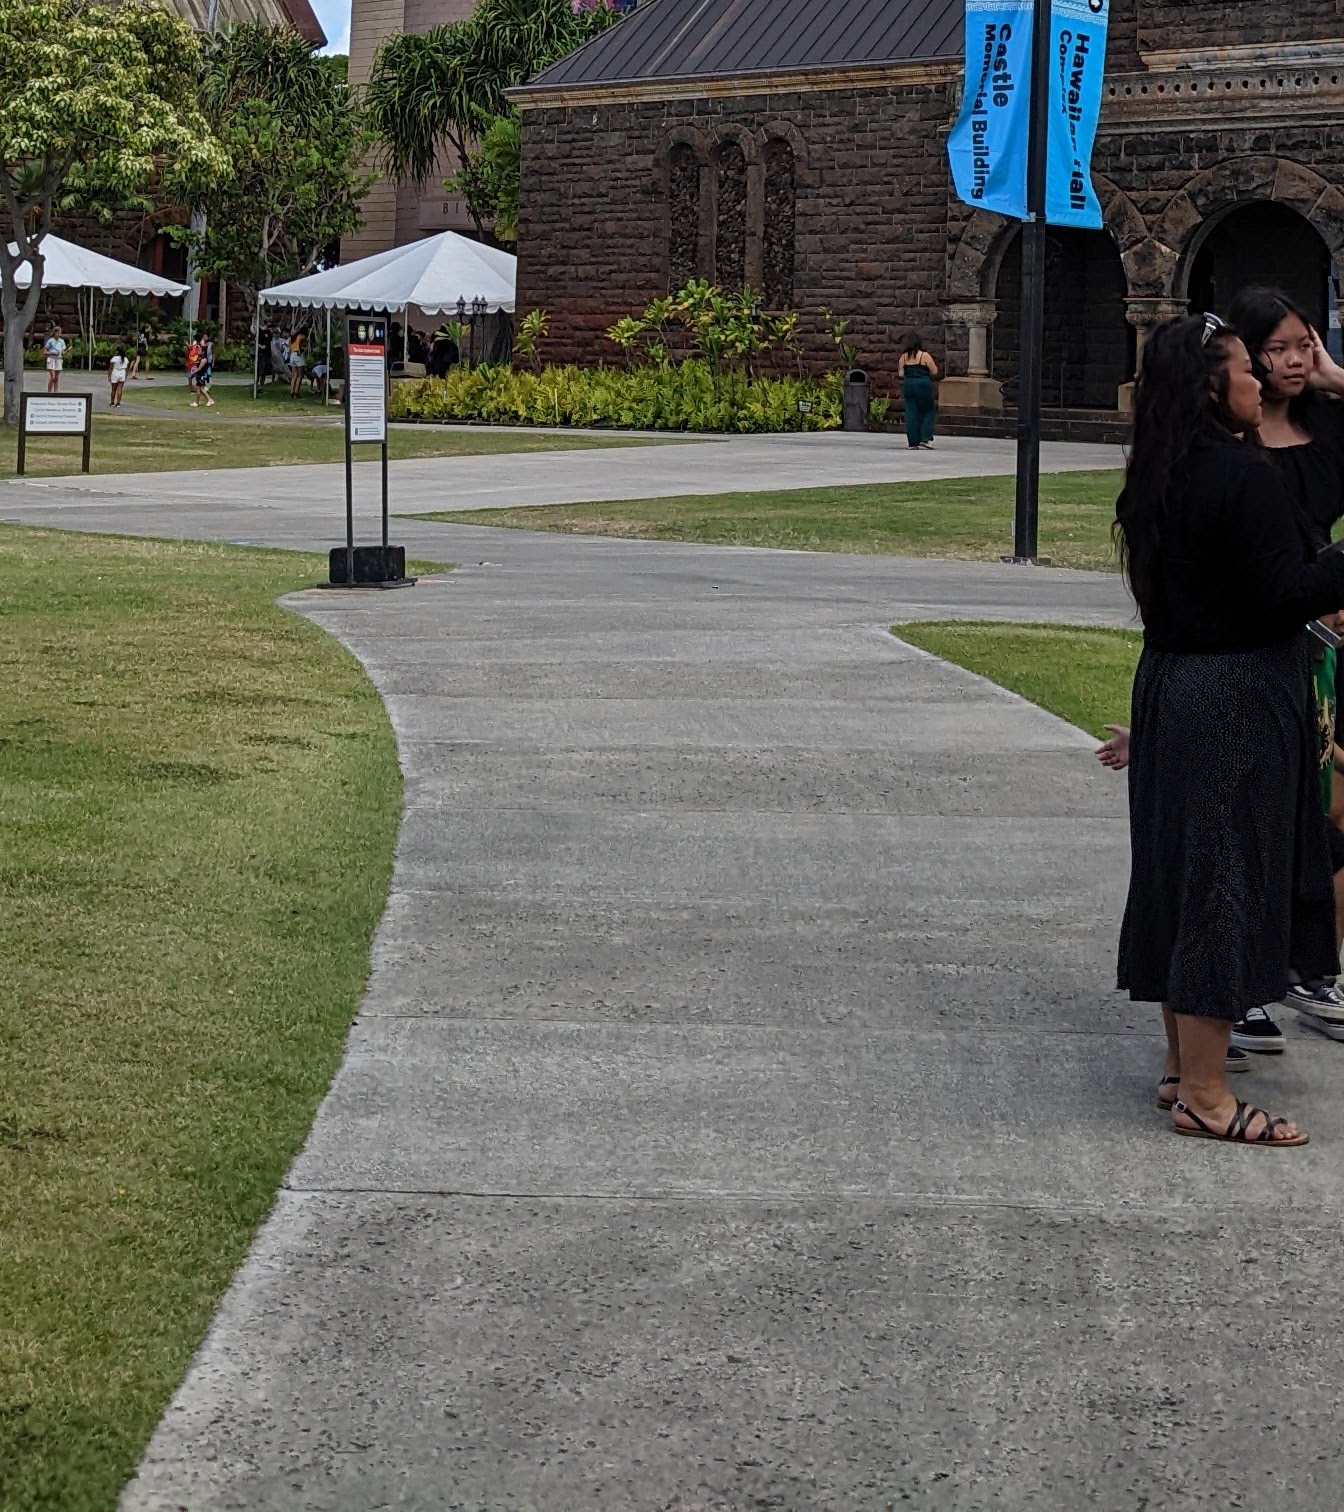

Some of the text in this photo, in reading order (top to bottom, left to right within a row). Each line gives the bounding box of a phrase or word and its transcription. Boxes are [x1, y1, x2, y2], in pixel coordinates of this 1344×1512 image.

[971, 23, 997, 200] Memorial Building
[992, 23, 1014, 108] Castle
[1067, 33, 1091, 152] Hawaiian
